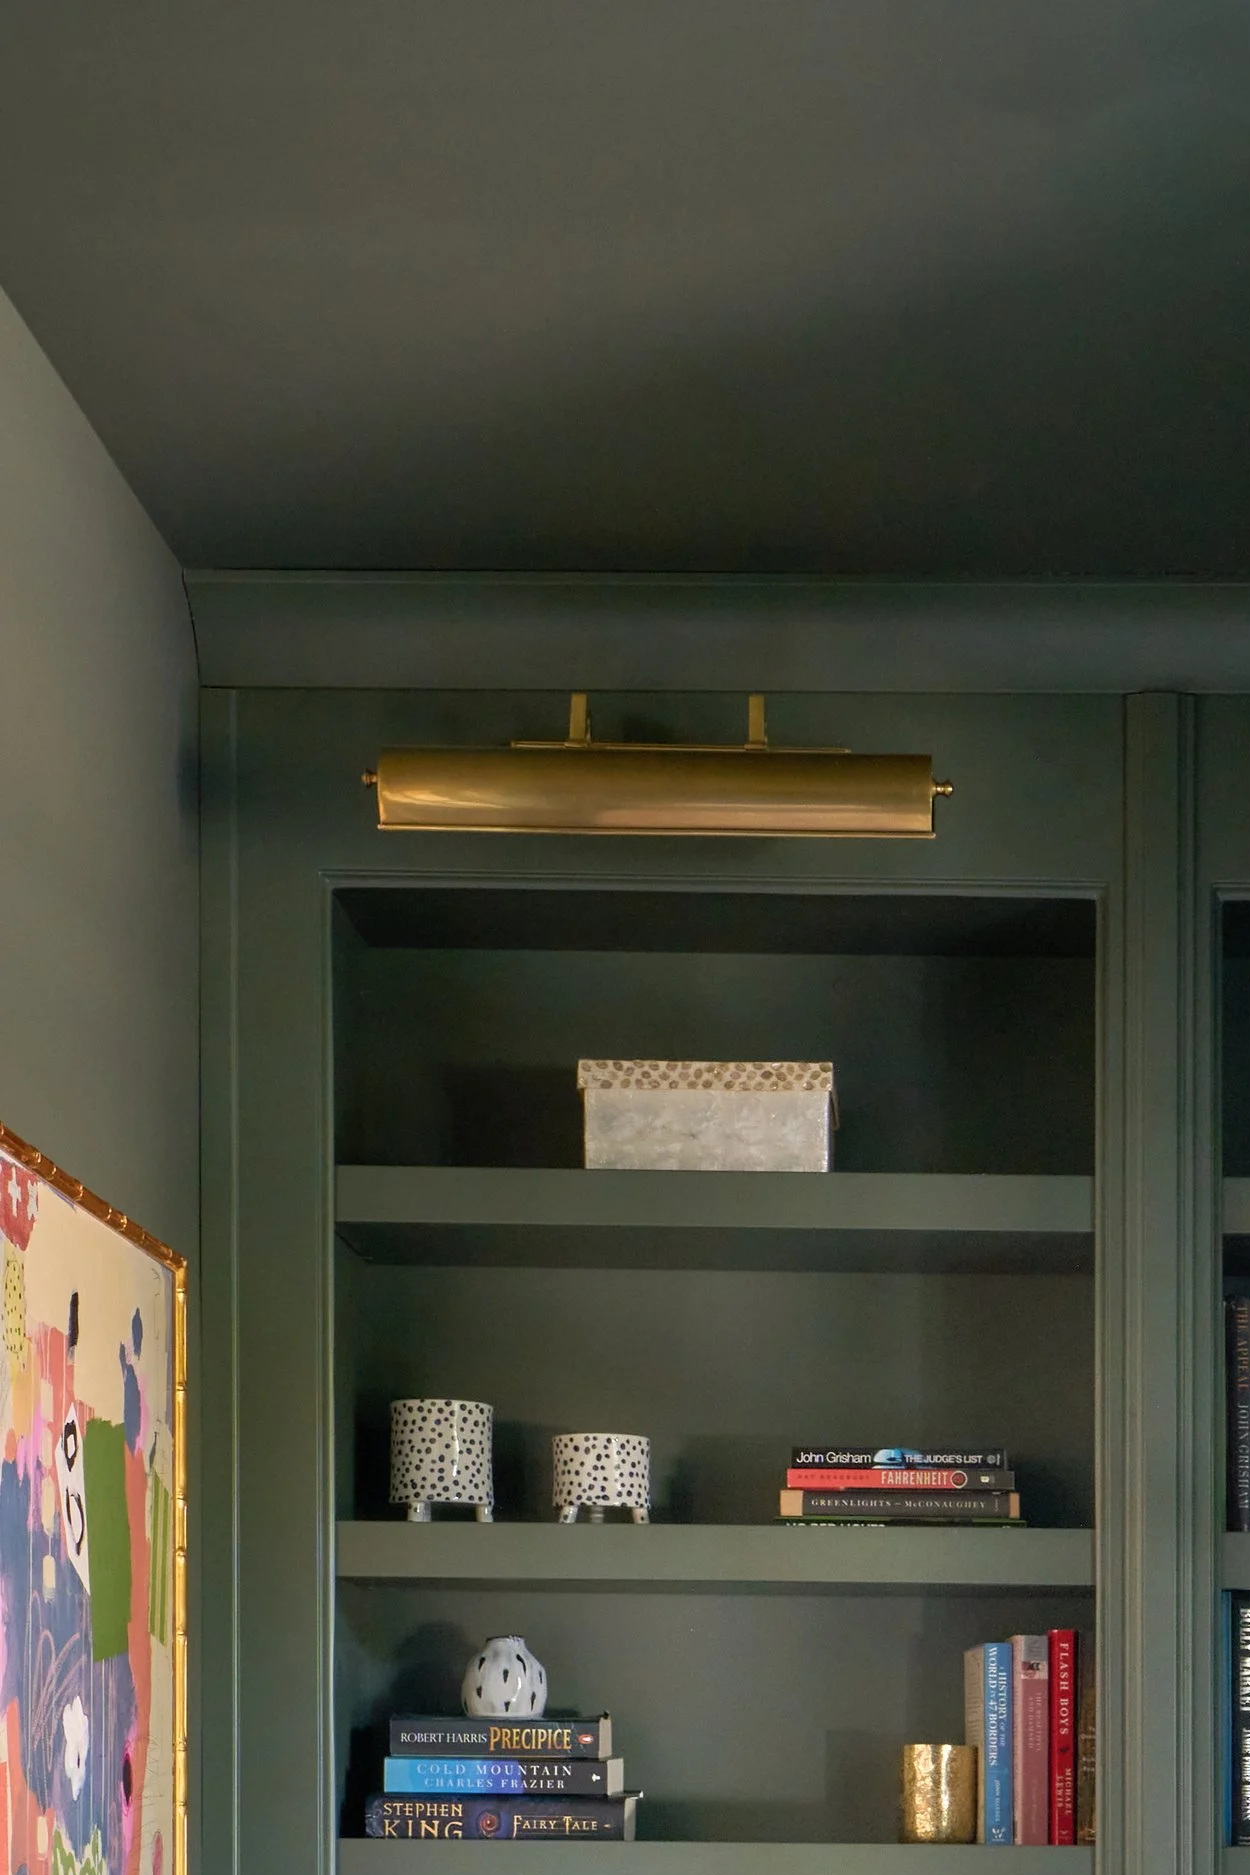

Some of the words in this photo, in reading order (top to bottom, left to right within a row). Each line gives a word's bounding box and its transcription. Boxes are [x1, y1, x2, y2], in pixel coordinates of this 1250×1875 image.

[1236, 1304, 1248, 1330] THE
[1236, 1338, 1248, 1391] APPEAL
[1238, 1403, 1249, 1439] JOHN
[796, 1452, 824, 1463] John
[826, 1452, 871, 1463] Grisham
[904, 1455, 924, 1464] THE
[924, 1455, 963, 1464] JUDGE'S
[963, 1455, 983, 1464] LIST
[881, 1471, 948, 1485] FAHRENHEIT
[1238, 1445, 1249, 1508] GRISHAM
[811, 1499, 891, 1507] GREENLIGHTS
[989, 1647, 998, 1688] WORLD
[1059, 1643, 1069, 1691] FLASH
[989, 1699, 998, 1712] 47
[998, 1672, 1007, 1720] HISTORY
[1059, 1698, 1069, 1736] BOYS
[400, 1732, 445, 1743] ROBERT
[447, 1733, 488, 1744] HARRIS
[488, 1726, 572, 1751] PRECIPICE
[989, 1714, 998, 1767] BORDERS
[417, 1763, 465, 1776] COLD
[476, 1763, 573, 1776] MOUNTAIN
[423, 1778, 493, 1789] CHARLES
[501, 1778, 566, 1789] FRAZIER
[1056, 1776, 1064, 1808] LEWIS
[383, 1802, 464, 1817] STEPHEN
[383, 1819, 463, 1838] KING
[513, 1815, 556, 1838] FAIRY
[563, 1816, 598, 1835] TALE
